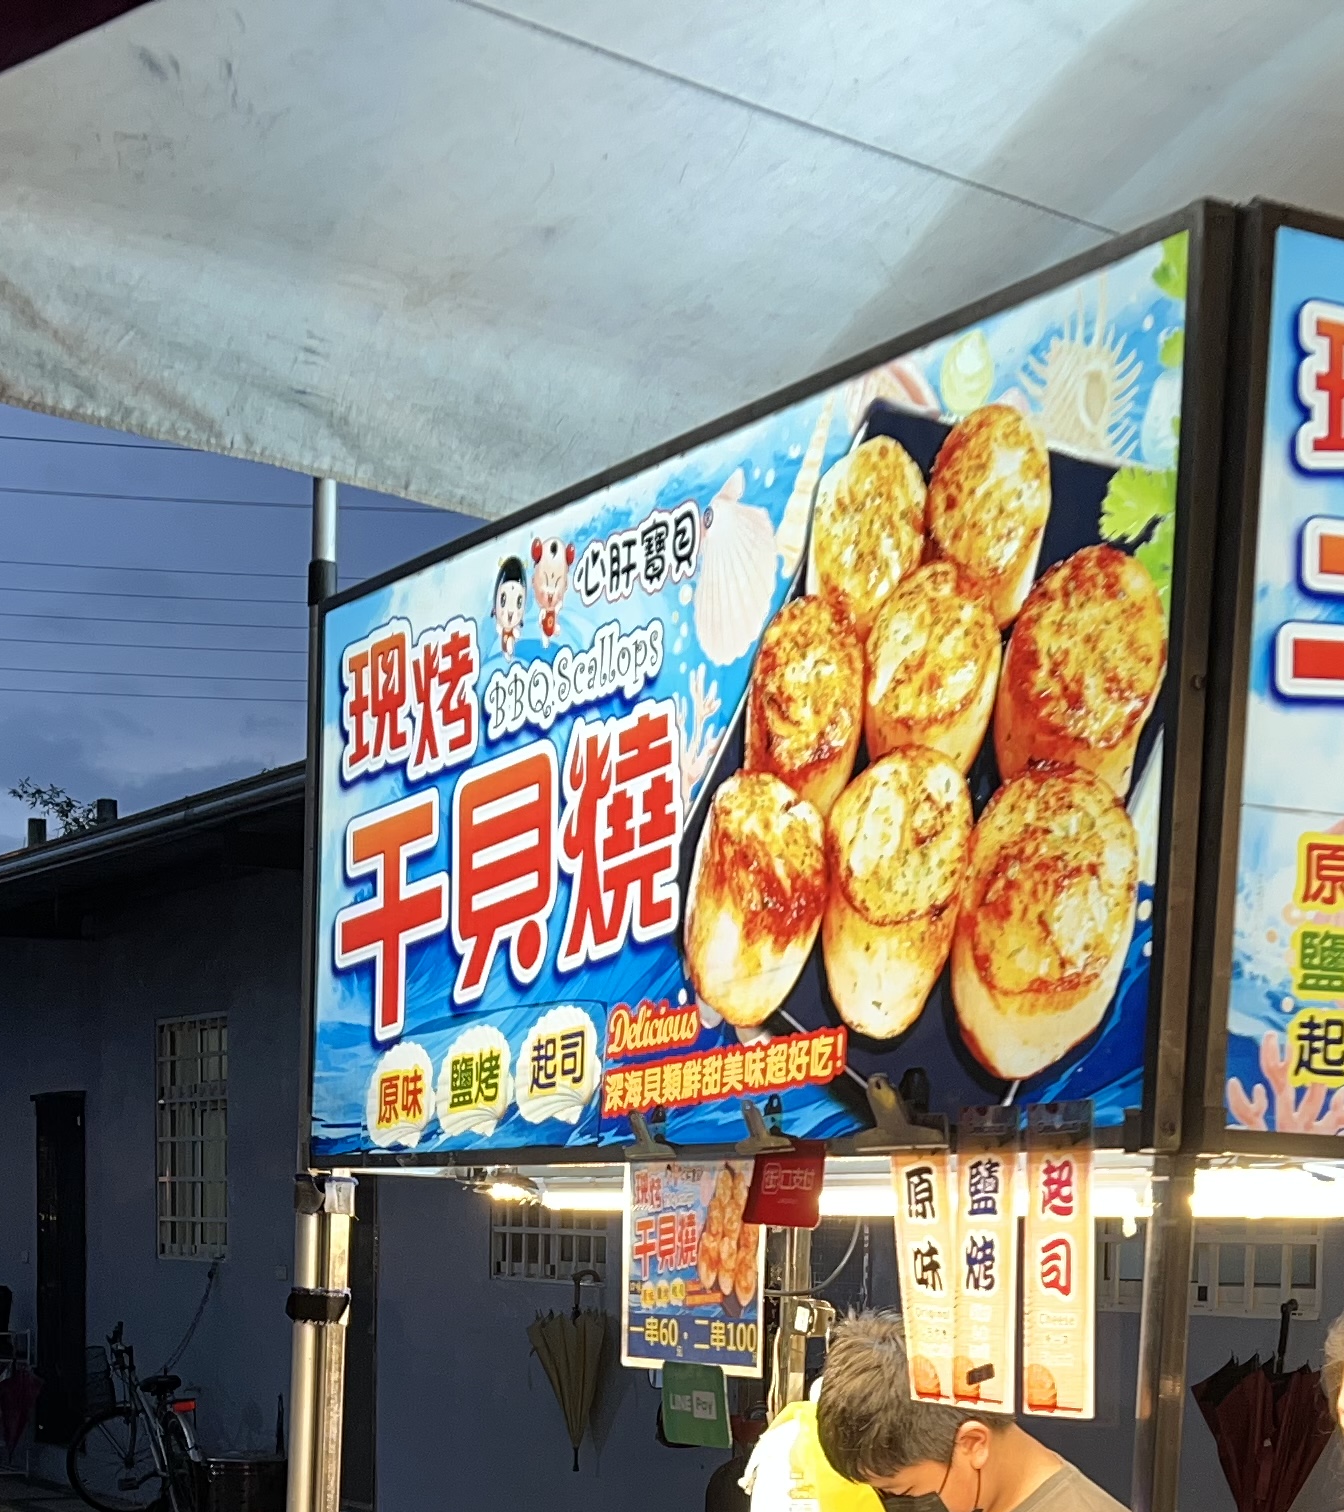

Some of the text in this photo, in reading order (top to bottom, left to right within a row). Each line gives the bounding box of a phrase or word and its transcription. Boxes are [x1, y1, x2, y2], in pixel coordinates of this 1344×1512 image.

[577, 509, 697, 596] 心肝寶貝
[347, 630, 474, 768] 現烤
[489, 628, 660, 730] BBQ Scallops
[341, 712, 676, 1028] 干貝燒
[529, 1031, 585, 1093] 起司
[607, 1004, 698, 1055] Delicious
[377, 1067, 424, 1125] 原味
[450, 1051, 501, 1109] 鹽烤
[633, 1210, 698, 1281] 干貝燒
[905, 1165, 944, 1292] 原味
[965, 1157, 1001, 1292] 鹽烤
[1040, 1157, 1074, 1297] 起司
[669, 1393, 692, 1412] LINE
